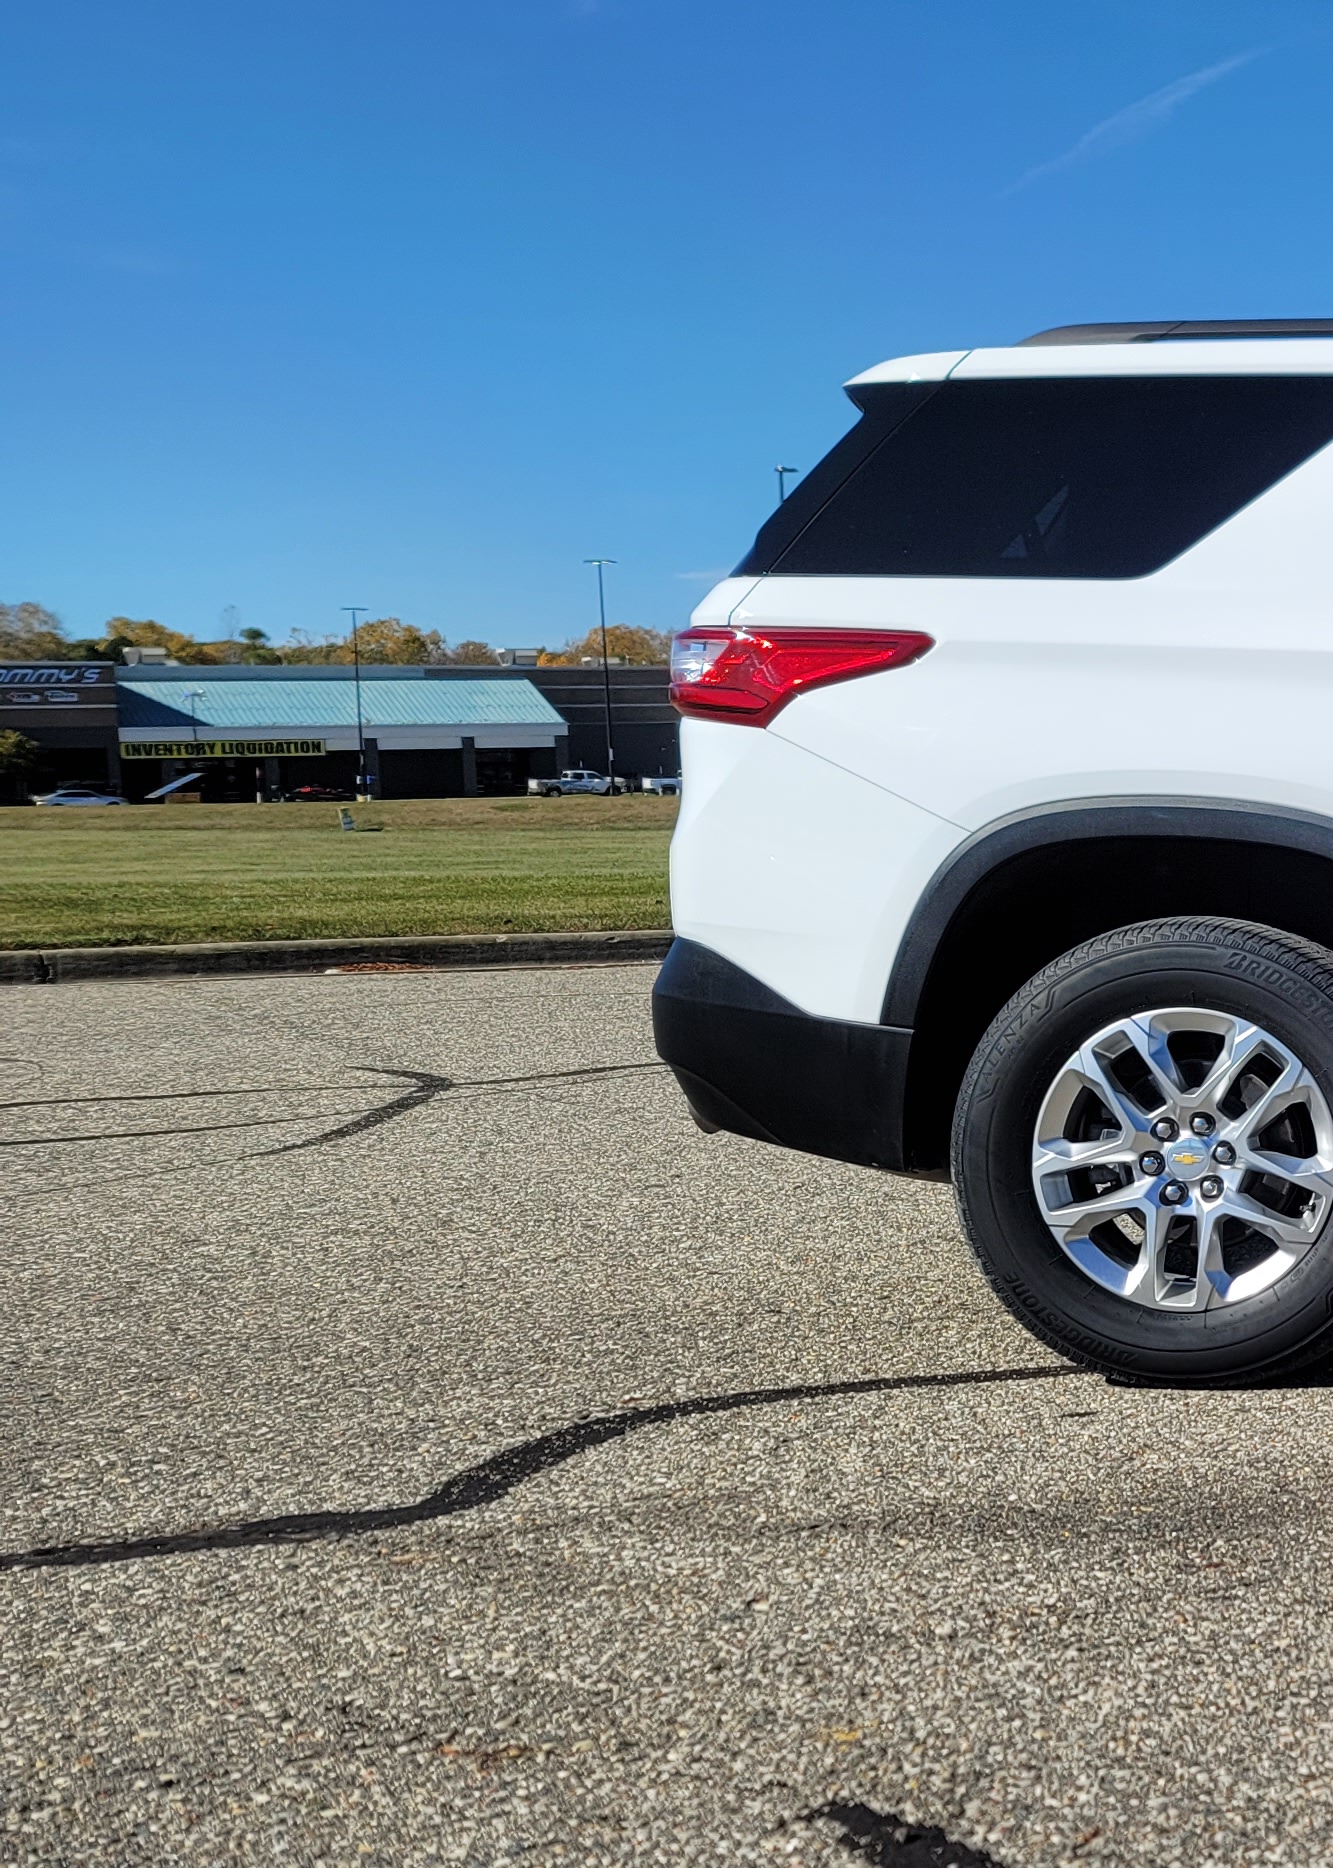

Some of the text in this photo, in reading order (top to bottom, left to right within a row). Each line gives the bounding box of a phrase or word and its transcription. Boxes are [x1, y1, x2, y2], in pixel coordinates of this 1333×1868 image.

[124, 740, 322, 756] INVENTORY LIQUIDATION
[982, 1002, 1041, 1085] ALENZA
